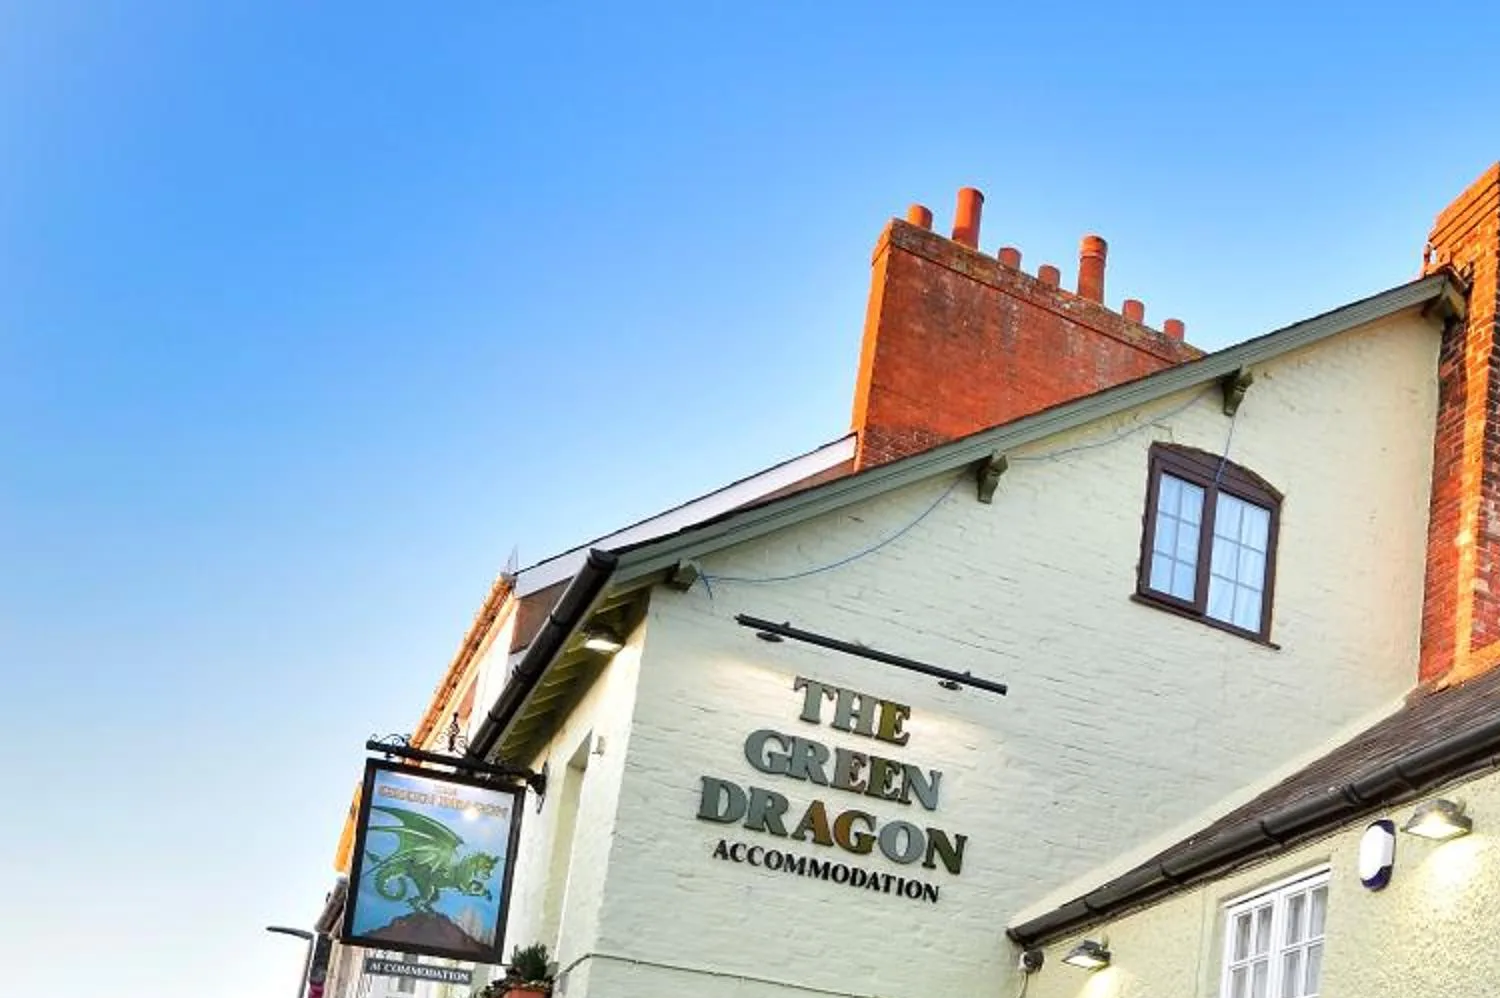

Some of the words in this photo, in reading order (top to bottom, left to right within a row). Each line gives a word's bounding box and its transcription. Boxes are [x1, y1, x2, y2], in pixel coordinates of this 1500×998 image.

[794, 675, 912, 746] THE
[744, 729, 943, 811] GREEN
[696, 775, 968, 875] DRAGON
[712, 839, 940, 903] ACCOMMODATION
[369, 963, 469, 981] ACCOMMODATION
